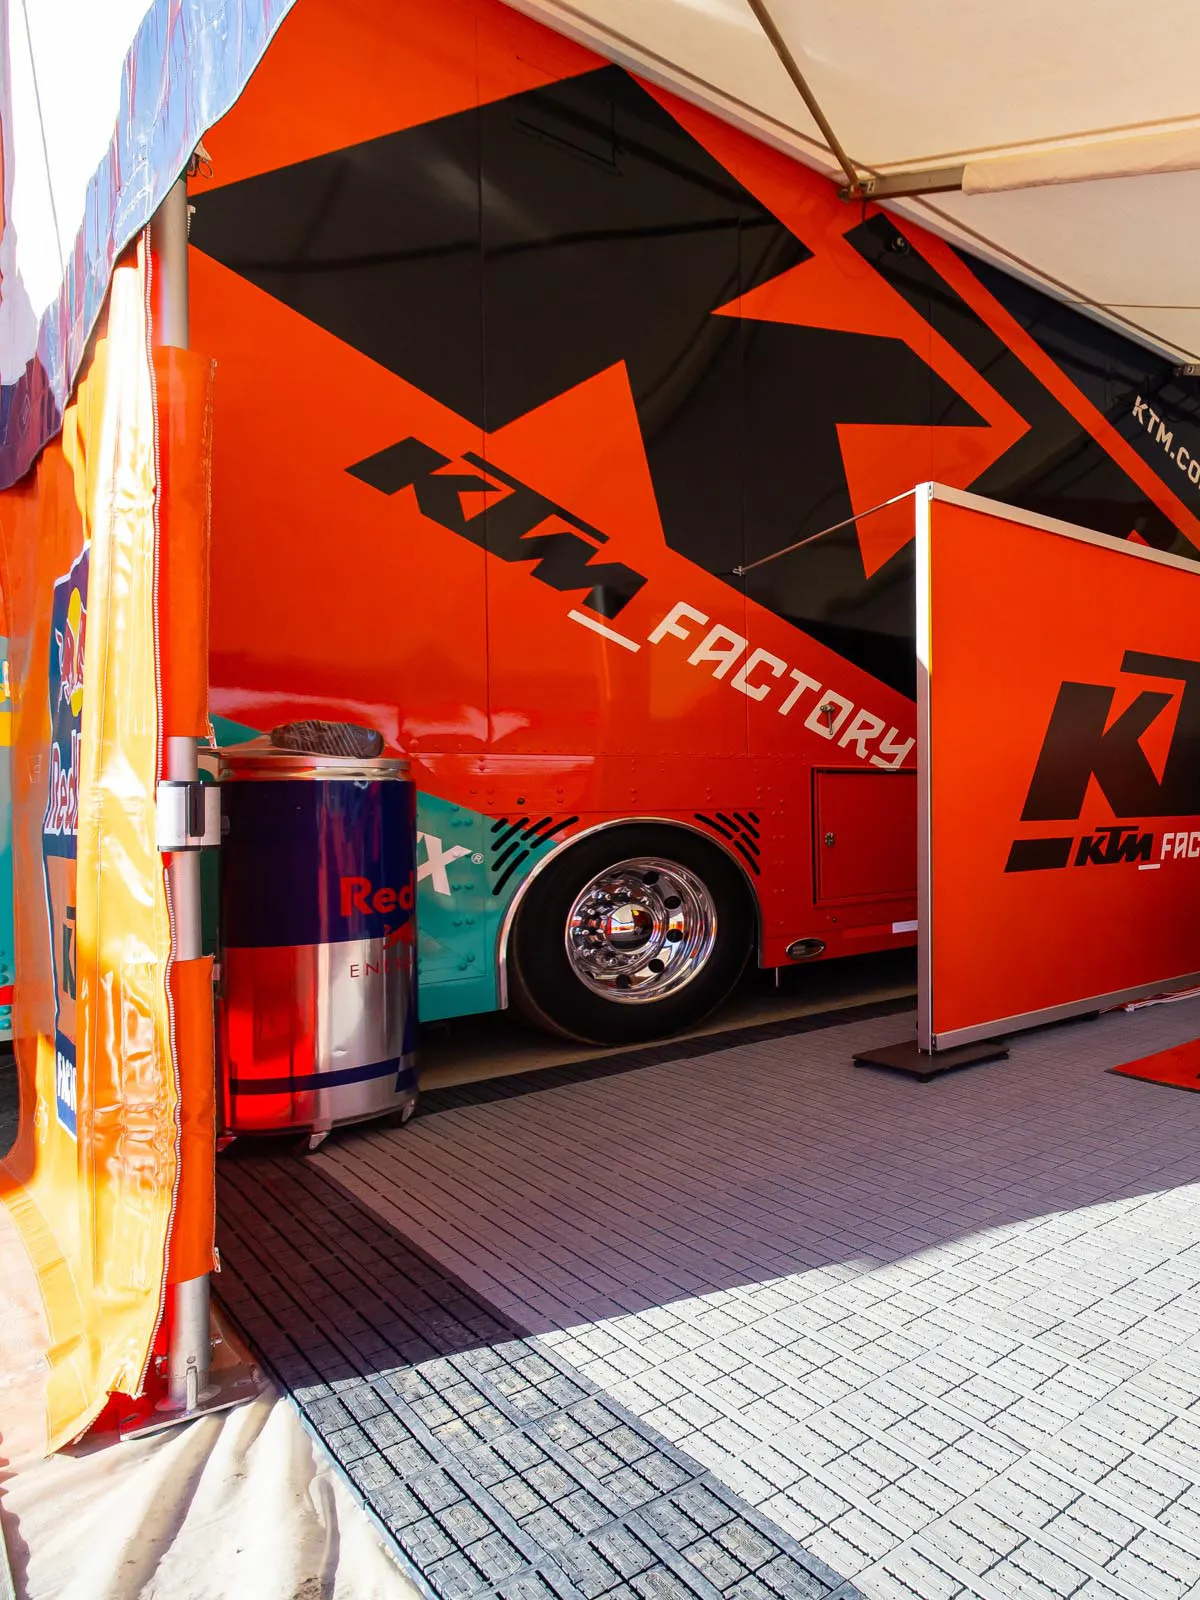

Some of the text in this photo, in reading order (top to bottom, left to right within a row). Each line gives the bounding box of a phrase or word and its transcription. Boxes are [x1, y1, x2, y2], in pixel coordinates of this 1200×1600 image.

[344, 436, 916, 771] KTM FACTORY
[1074, 826, 1153, 866] KTM
[340, 870, 415, 917] Red
